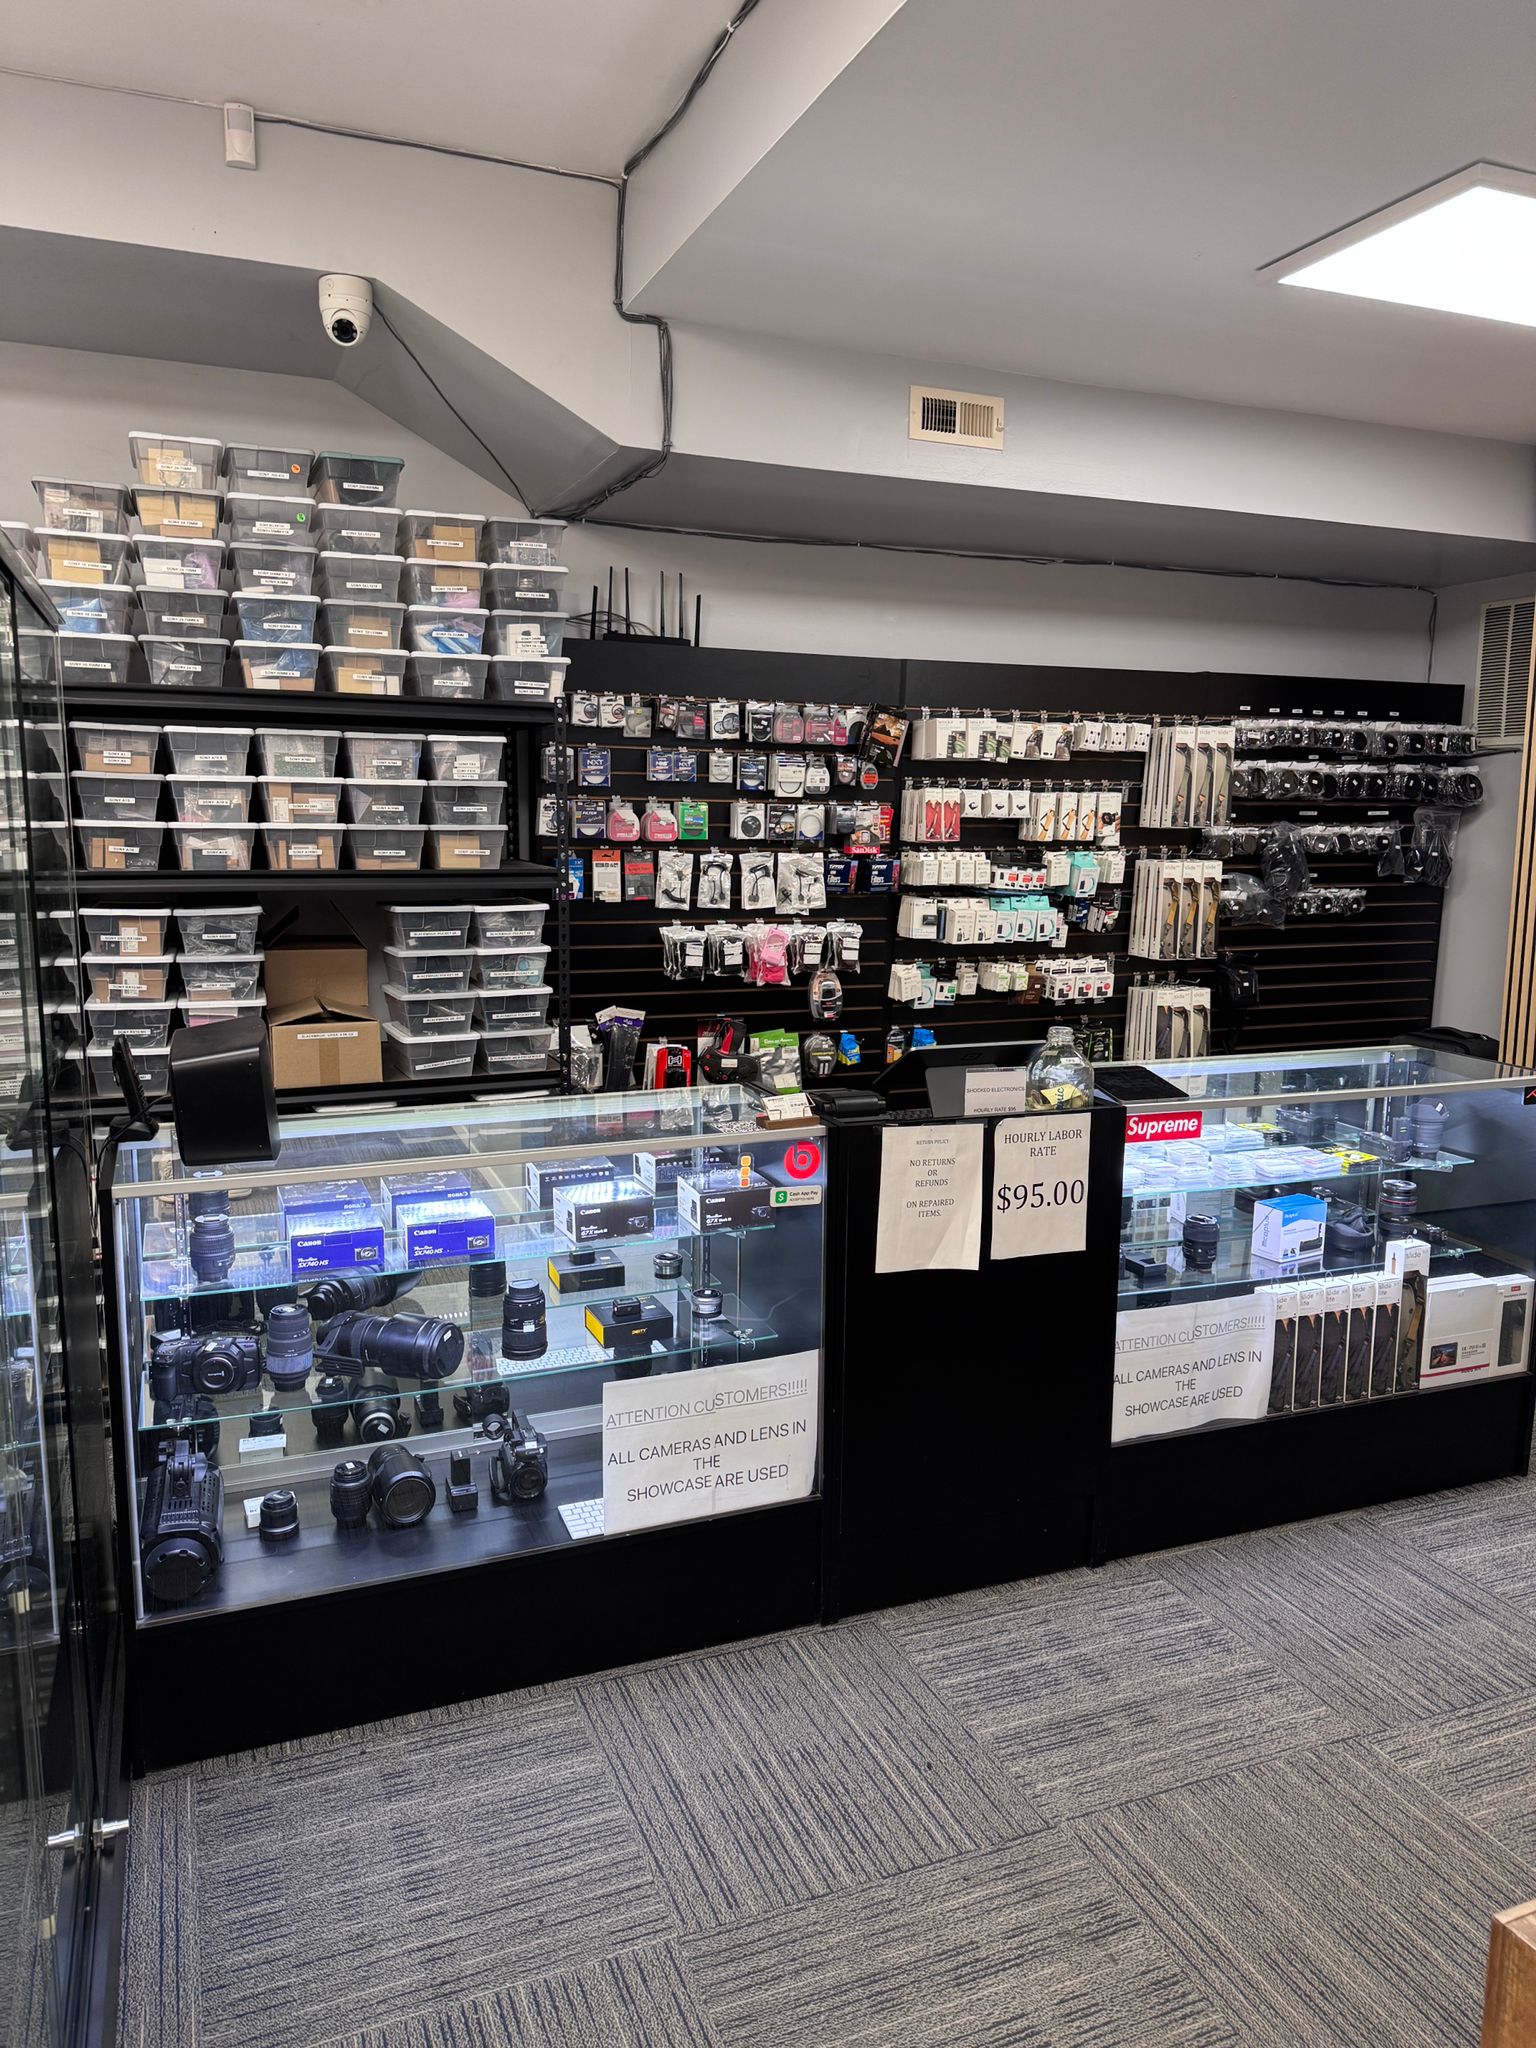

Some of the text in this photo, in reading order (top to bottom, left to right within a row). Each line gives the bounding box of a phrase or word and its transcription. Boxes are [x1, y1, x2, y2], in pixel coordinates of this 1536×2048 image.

[1128, 1116, 1198, 1139] Supreme
[1005, 1129, 1082, 1144] HOURLY LABOR
[1030, 1146, 1056, 1157] RATE
[923, 1158, 956, 1166] RETURNS
[915, 1179, 948, 1187] REFUNDS
[919, 1199, 954, 1207] REPAIRED
[997, 1180, 1085, 1213] $95.00
[414, 1228, 436, 1236] Canon
[297, 1239, 321, 1247] Canon
[1115, 1333, 1176, 1351] ATTENTION
[1114, 1351, 1262, 1384] ALL CAMERAS AND LENS IN
[1176, 1379, 1196, 1391] THE
[1125, 1386, 1242, 1416] SHOWCASE ARE USED
[607, 1403, 689, 1427] ATTENTION
[608, 1420, 806, 1465] ALL CAMERAS AND LENS IN
[693, 1455, 720, 1470] THE
[628, 1464, 788, 1502] SHOWCASE ARE USED
